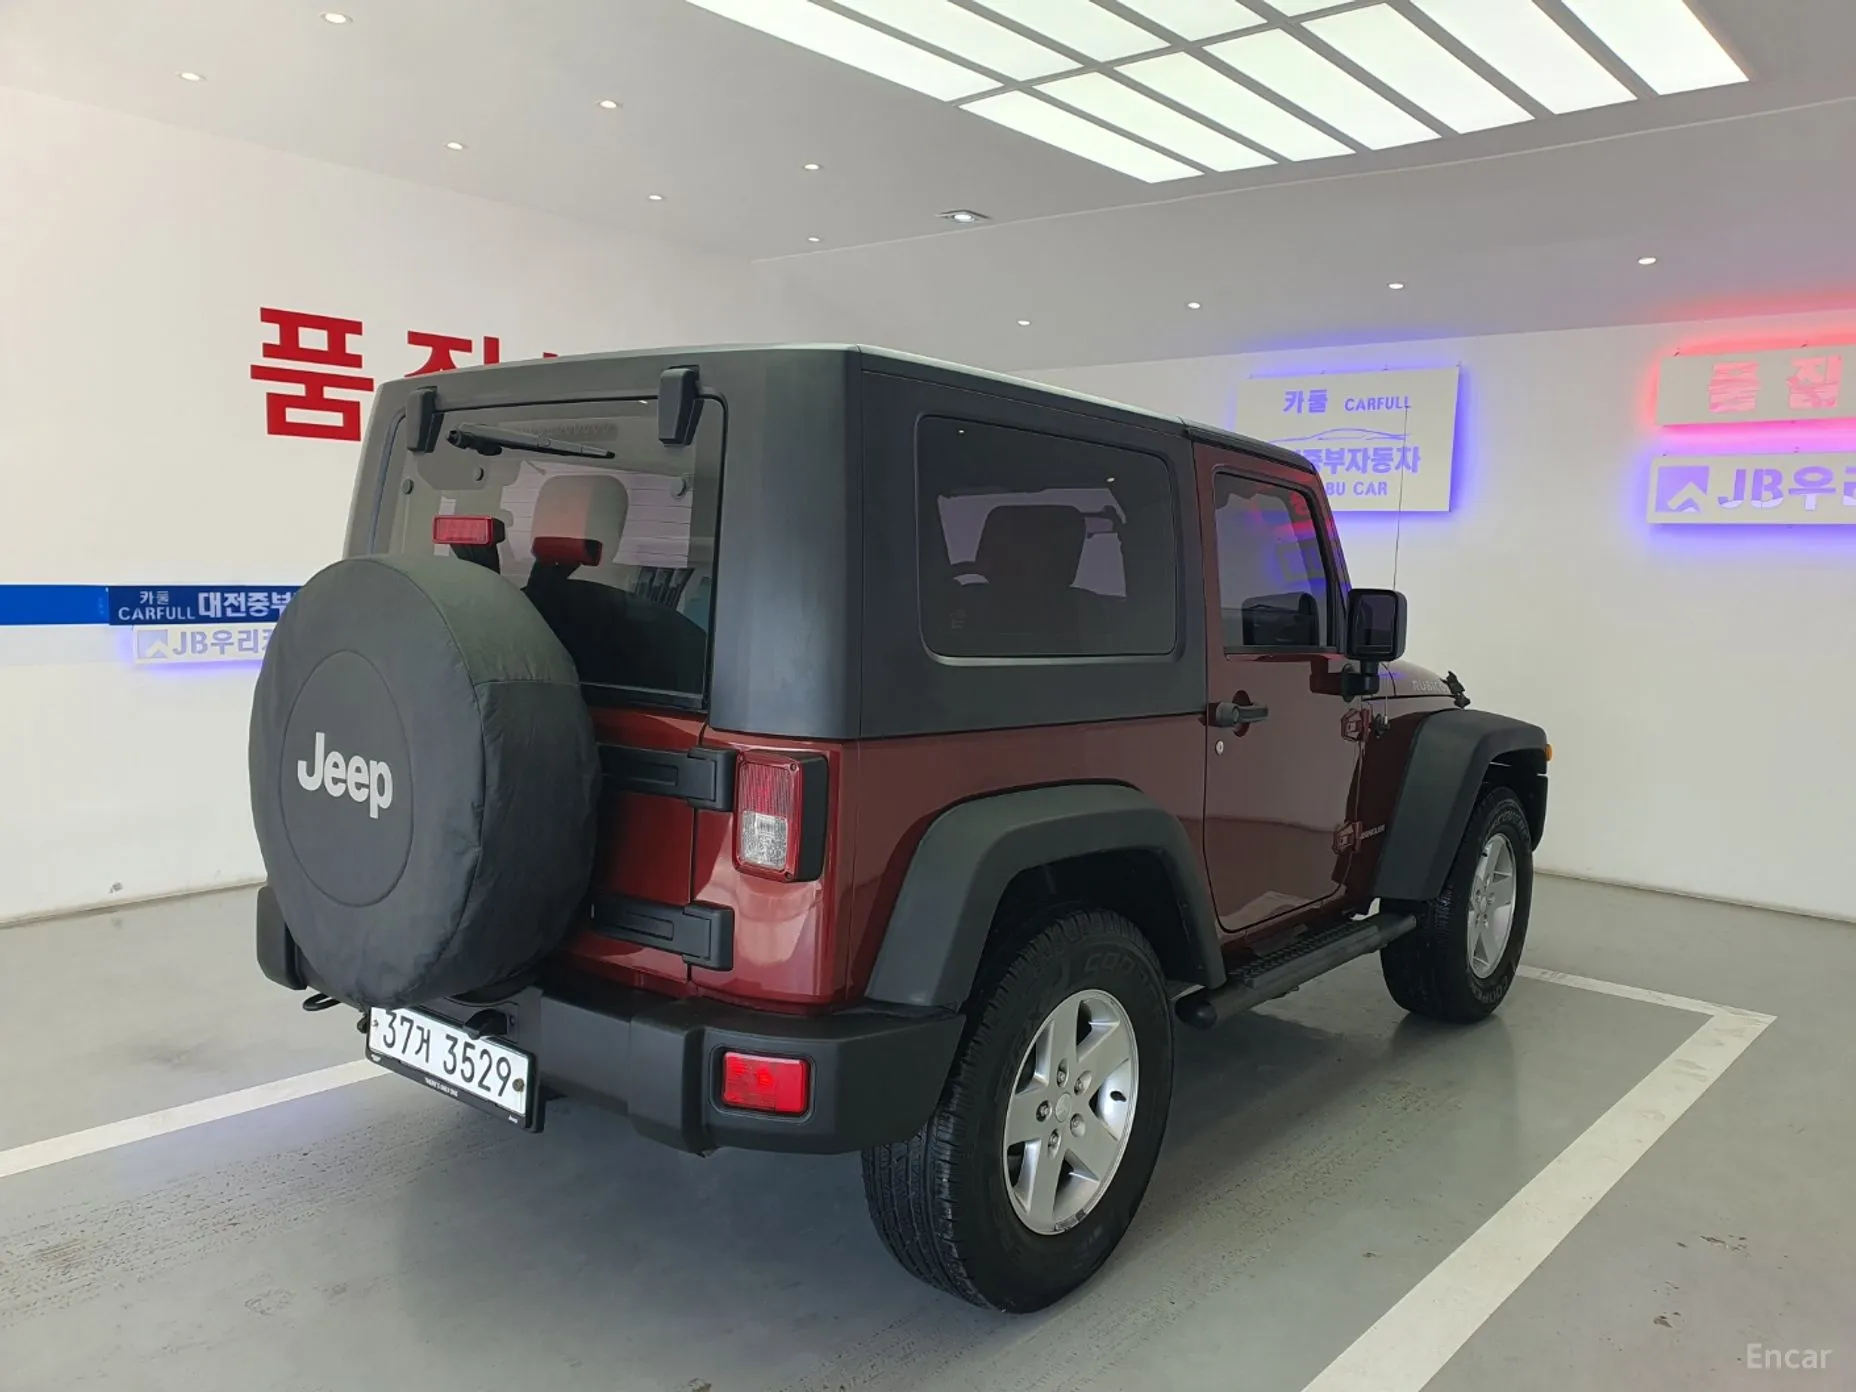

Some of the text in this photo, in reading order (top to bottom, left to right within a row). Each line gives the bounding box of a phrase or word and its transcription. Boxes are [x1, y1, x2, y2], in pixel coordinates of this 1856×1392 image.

[1344, 395, 1412, 412] CARFULL
[1353, 480, 1388, 496] CAR
[1717, 465, 1856, 511] JB우
[118, 606, 196, 621] CARFULL
[198, 591, 297, 619] 대전중부
[172, 628, 272, 656] JB우리
[297, 731, 393, 819] Jeep
[383, 1009, 512, 1097] 37거 3529
